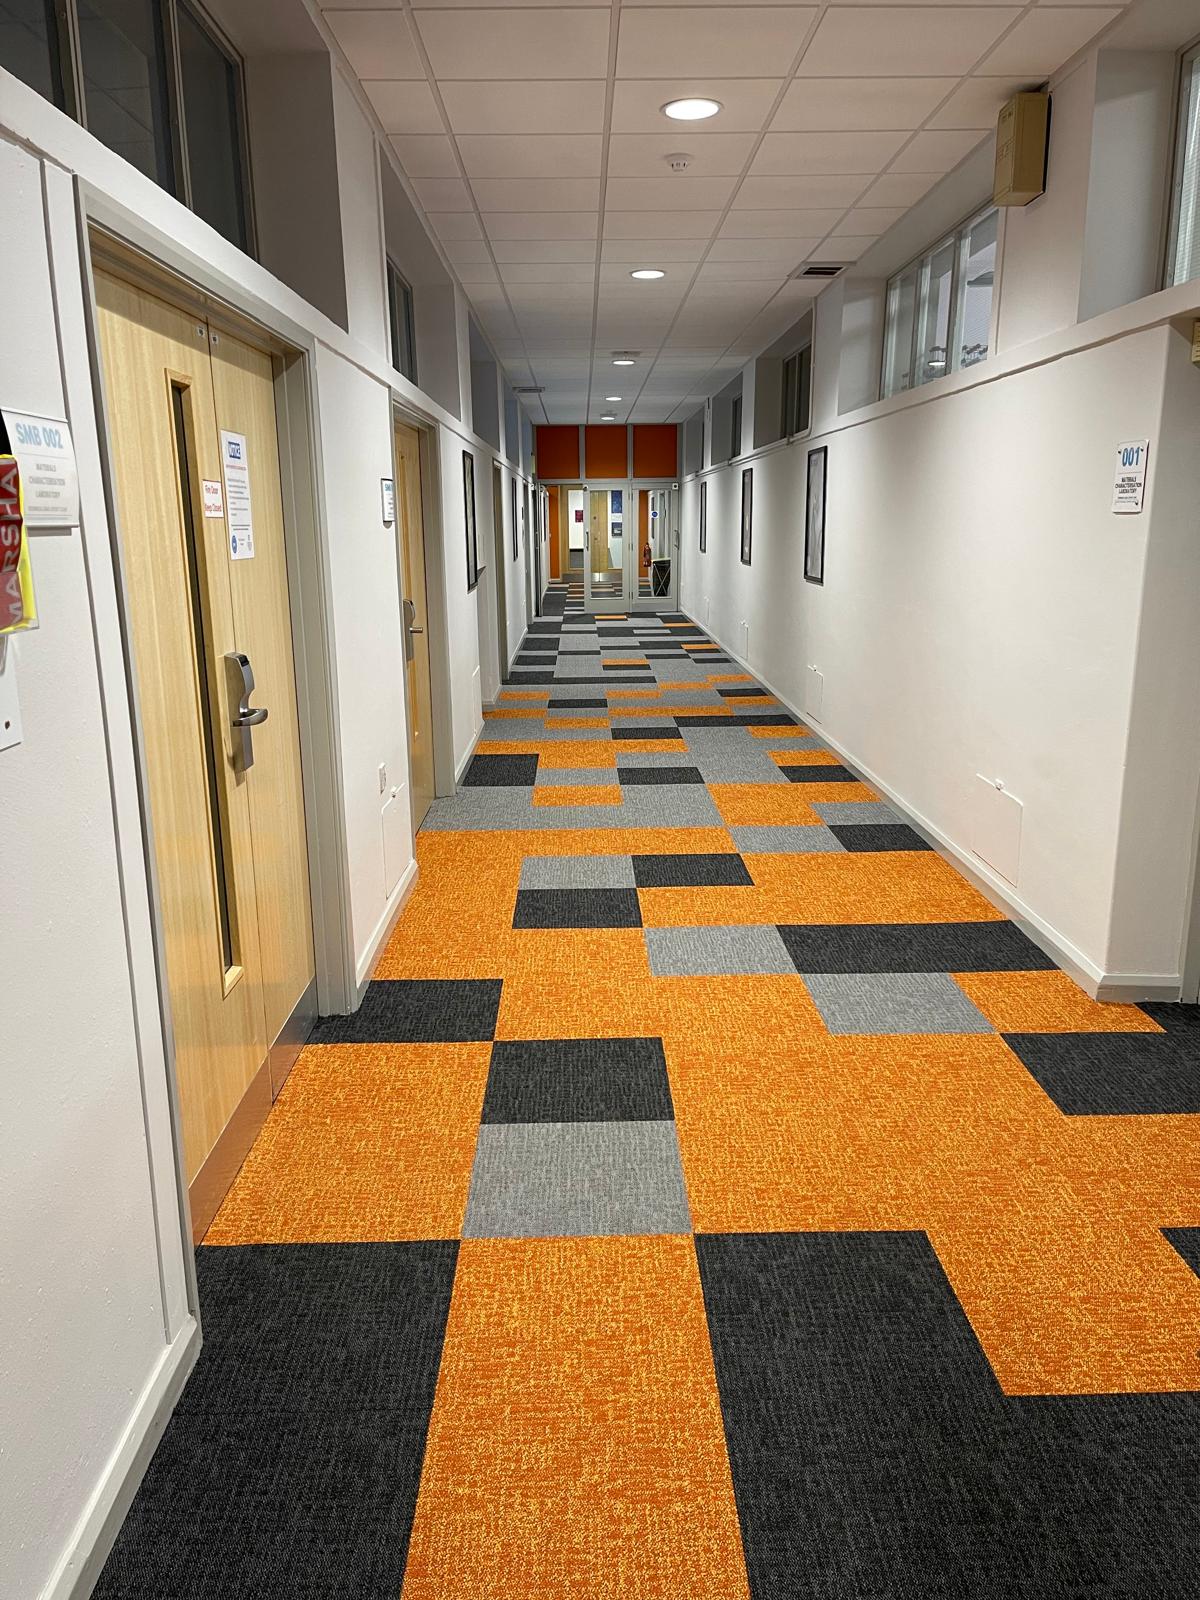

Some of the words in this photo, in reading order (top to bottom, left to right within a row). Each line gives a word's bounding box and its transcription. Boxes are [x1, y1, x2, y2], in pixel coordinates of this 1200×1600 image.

[15, 422, 42, 446] SMB
[42, 426, 64, 449] 002
[1122, 446, 1140, 467] 001
